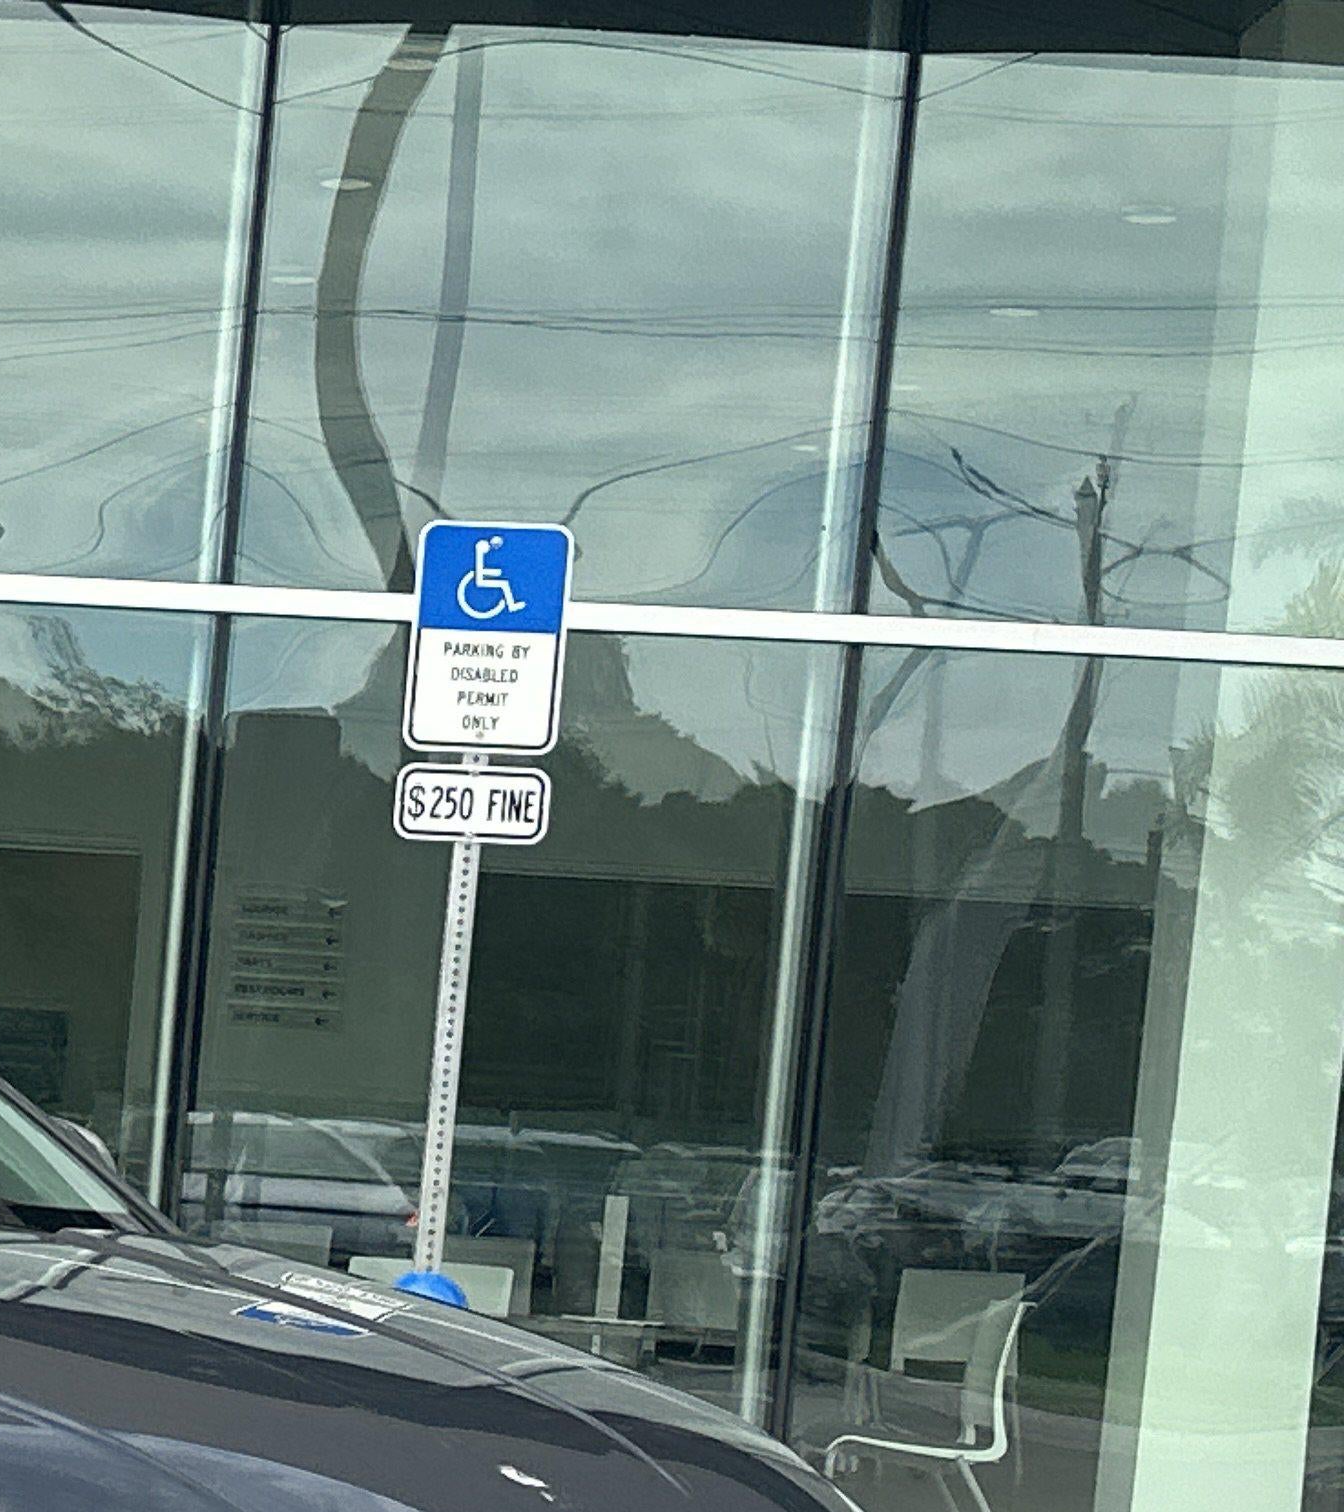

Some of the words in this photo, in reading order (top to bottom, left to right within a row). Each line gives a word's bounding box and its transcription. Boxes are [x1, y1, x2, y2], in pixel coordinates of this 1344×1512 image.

[444, 641, 504, 659] PARKING
[512, 645, 531, 660] BY
[451, 666, 519, 683] DISABLED
[456, 690, 509, 706] PERMIT
[462, 714, 500, 730] ONLY
[408, 783, 473, 820] $250
[486, 789, 536, 824] FINE
